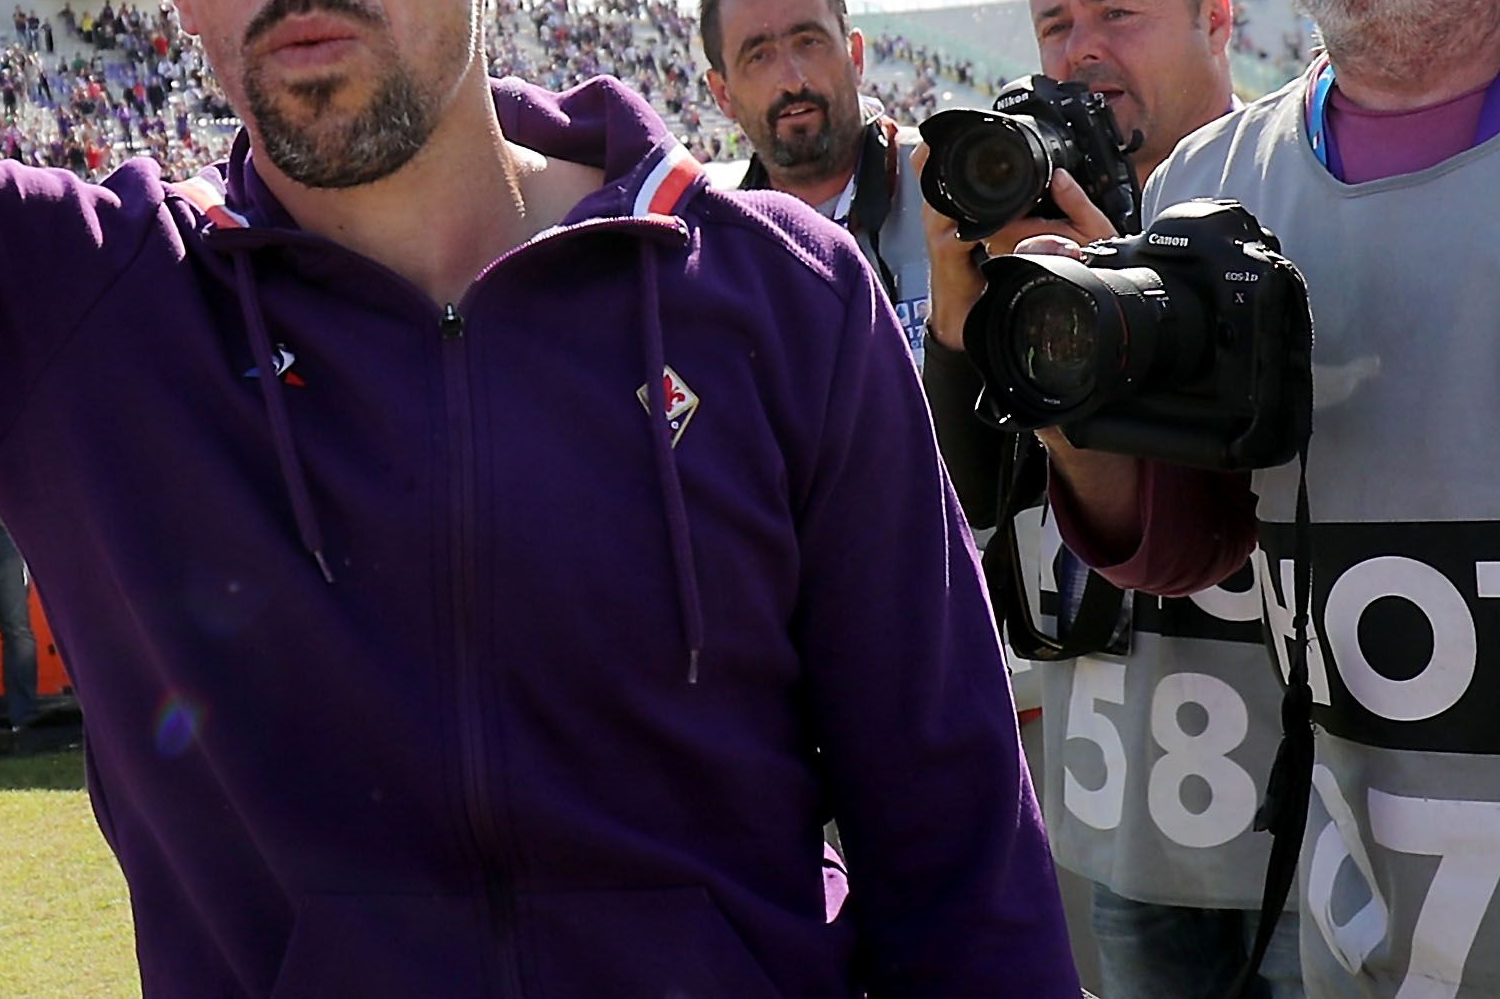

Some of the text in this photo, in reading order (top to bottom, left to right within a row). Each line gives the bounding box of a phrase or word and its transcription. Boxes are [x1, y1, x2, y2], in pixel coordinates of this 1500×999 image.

[997, 92, 1029, 111] Nikon
[1148, 233, 1189, 247] Canon
[1234, 292, 1245, 304] X
[1064, 658, 1258, 848] 58
